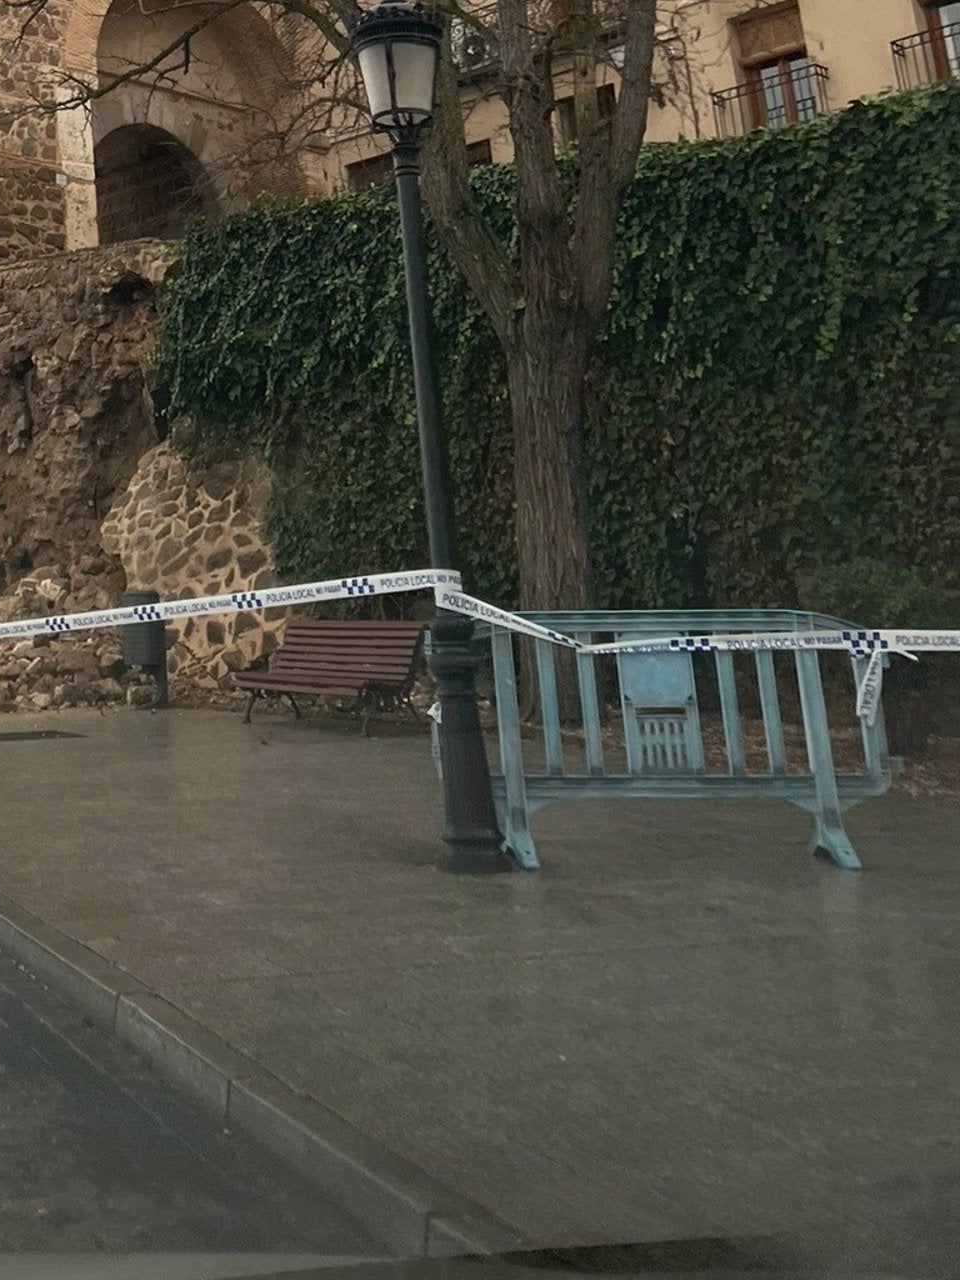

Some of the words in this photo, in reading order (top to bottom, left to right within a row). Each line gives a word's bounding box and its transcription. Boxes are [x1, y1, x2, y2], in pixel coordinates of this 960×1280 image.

[379, 577, 409, 589] POLICIA
[410, 575, 436, 586] LOCAL
[266, 591, 292, 603] POLICIA
[292, 588, 315, 600] LOCAL
[442, 593, 478, 613] POLICIA
